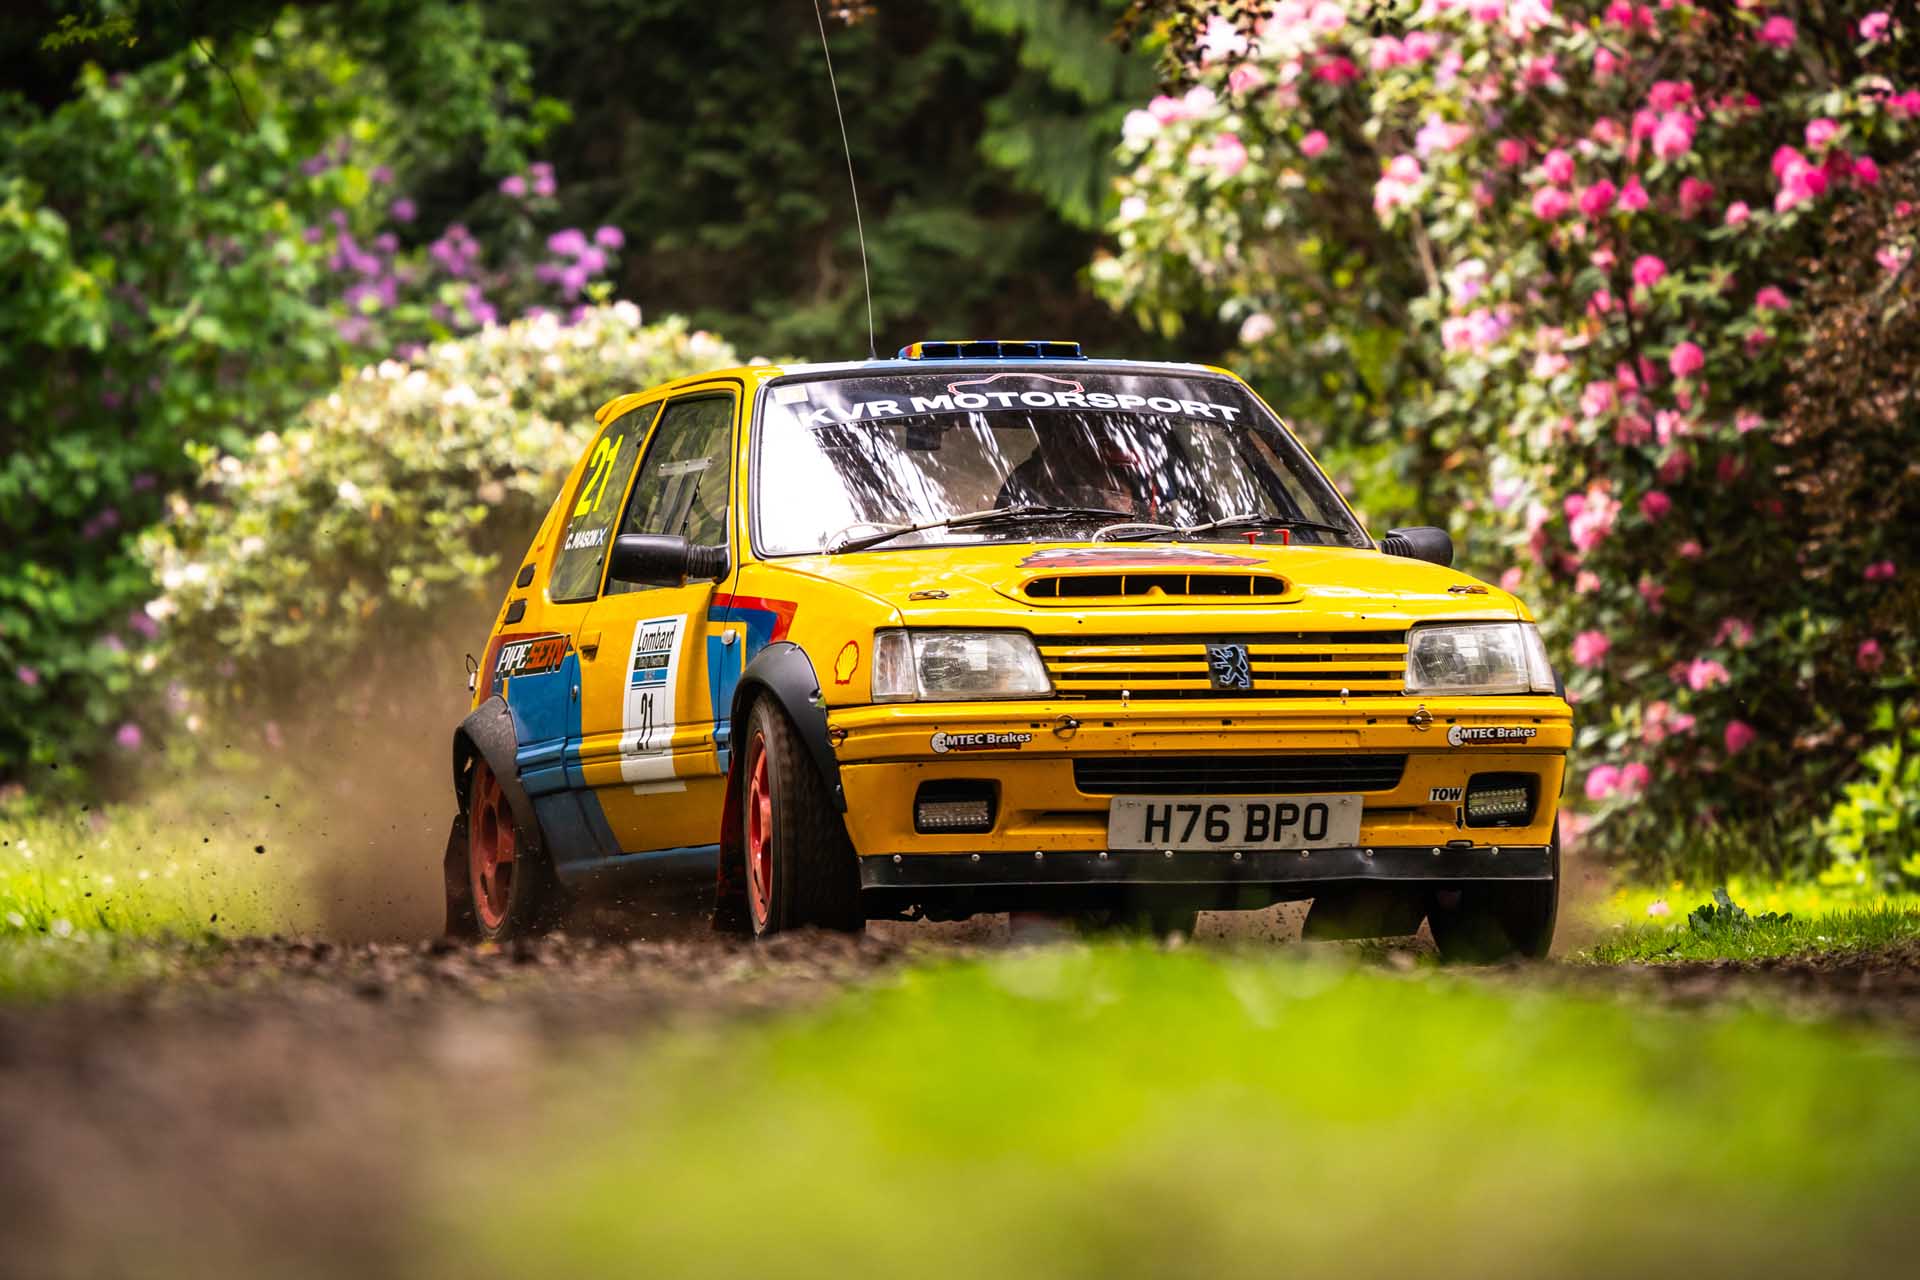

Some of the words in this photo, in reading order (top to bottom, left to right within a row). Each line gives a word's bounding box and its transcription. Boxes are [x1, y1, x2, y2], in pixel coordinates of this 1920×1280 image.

[803, 399, 904, 426] KVR
[910, 391, 1240, 422] MOTORSPORT
[573, 434, 624, 517] 21
[637, 625, 676, 652] Lombard
[637, 692, 653, 751] 21
[1461, 728, 1495, 739] MTEC
[1497, 727, 1536, 738] Brakes
[946, 734, 983, 746] MTEC
[986, 732, 1031, 744] Brakes
[1432, 788, 1462, 801] TOW
[1144, 804, 1231, 843] H76
[1244, 802, 1329, 842] BPO
